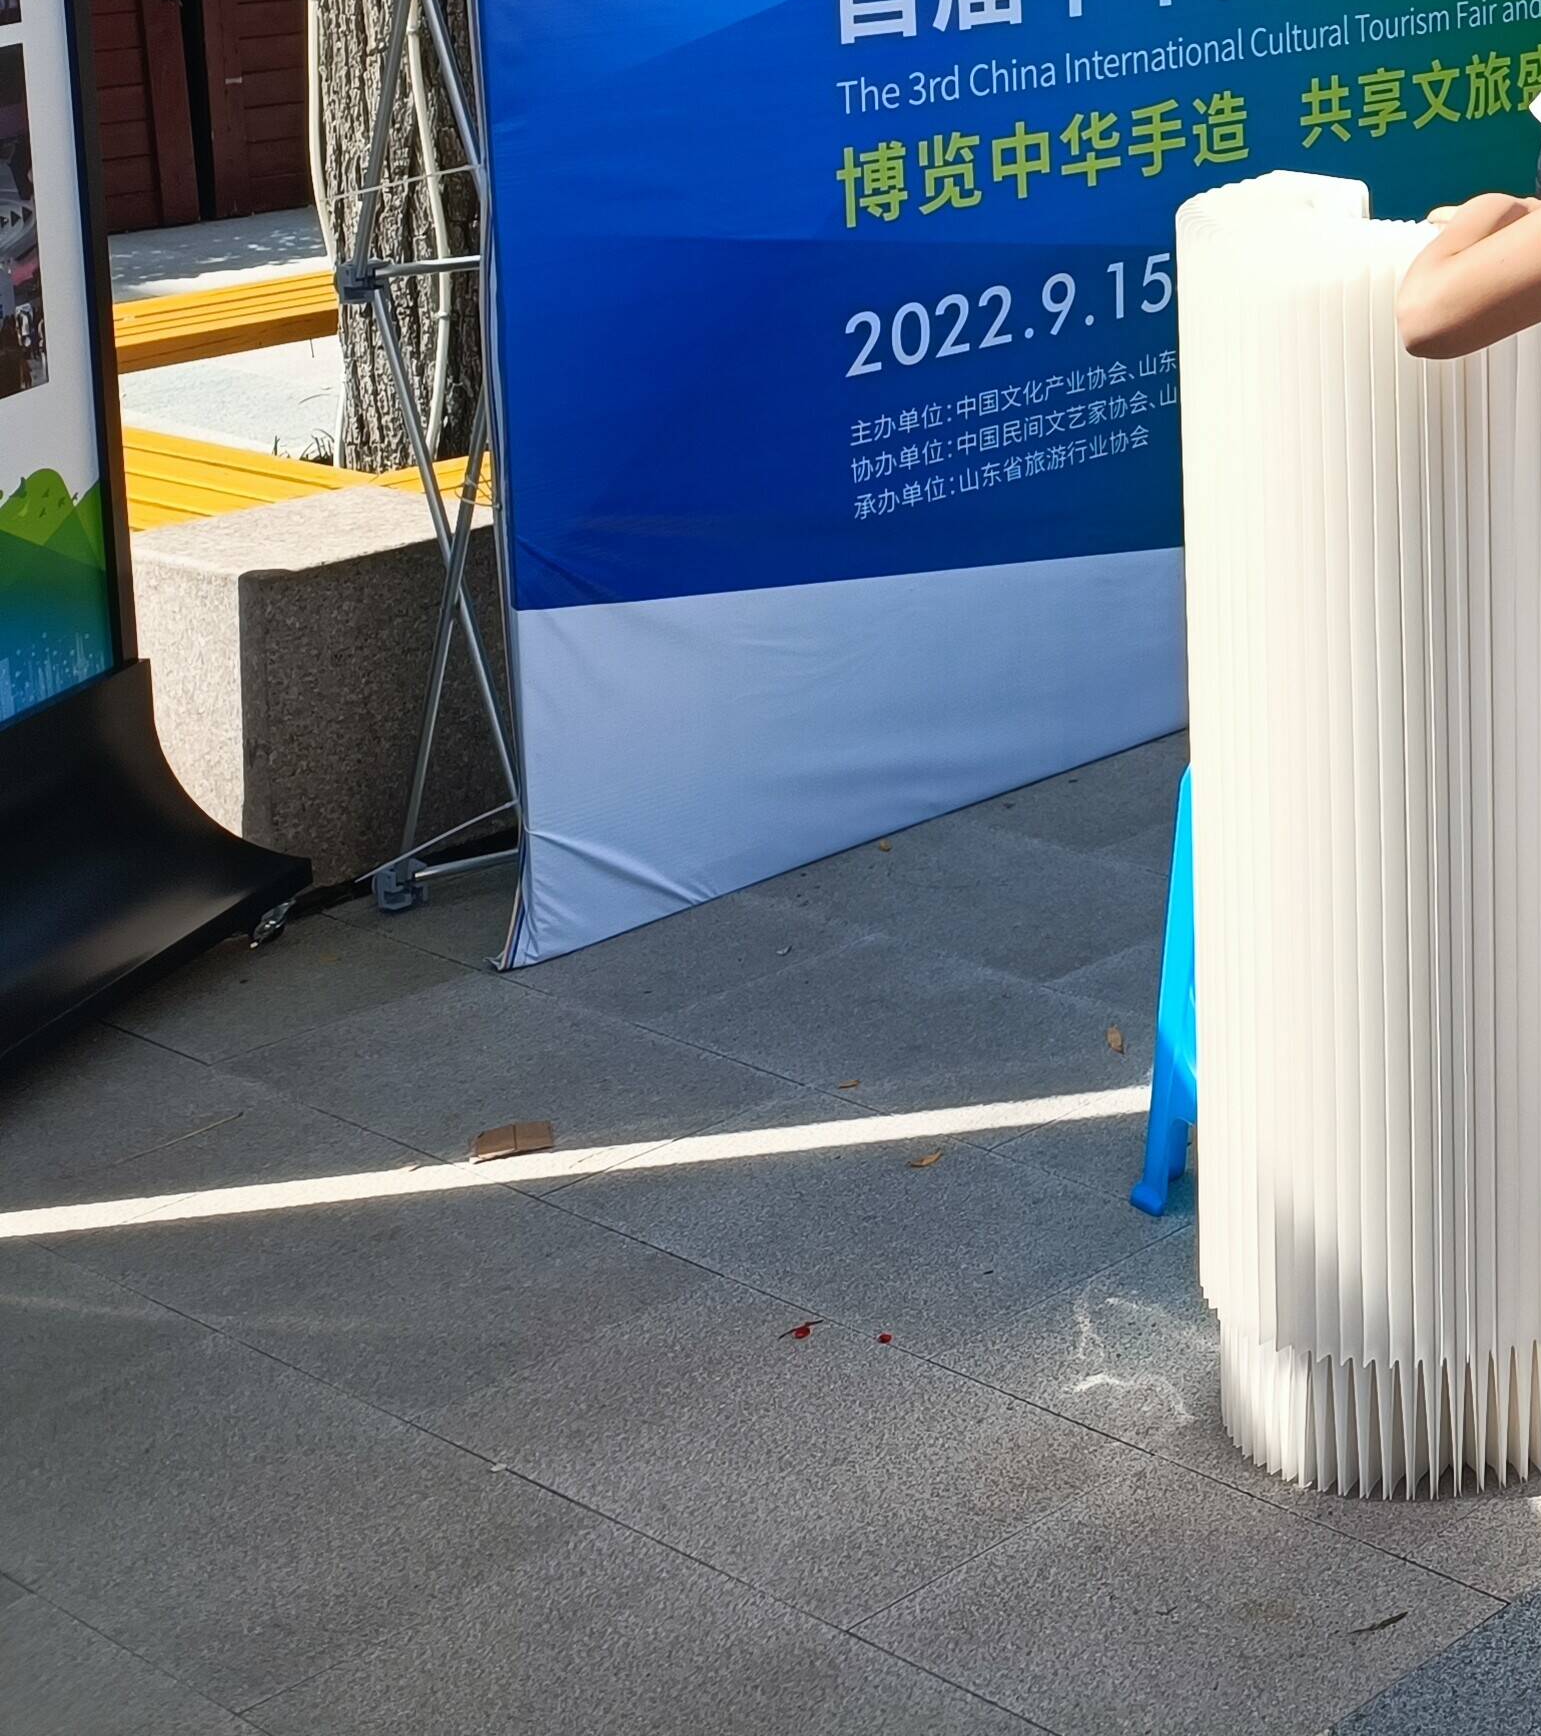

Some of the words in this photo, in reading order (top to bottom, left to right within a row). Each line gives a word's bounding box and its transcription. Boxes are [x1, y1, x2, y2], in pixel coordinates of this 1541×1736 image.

[836, 79, 901, 115] The
[908, 65, 961, 107] 3rd
[968, 58, 1057, 97] China
[1065, 26, 1244, 84] International
[1250, 10, 1350, 59] Cultural
[1355, 2, 1450, 43] Tourism
[835, 89, 1250, 229] 博览中华手造
[845, 252, 1173, 378] 2022.9.15
[853, 424, 1150, 521] 承办单位：山东省旅游行业协会
